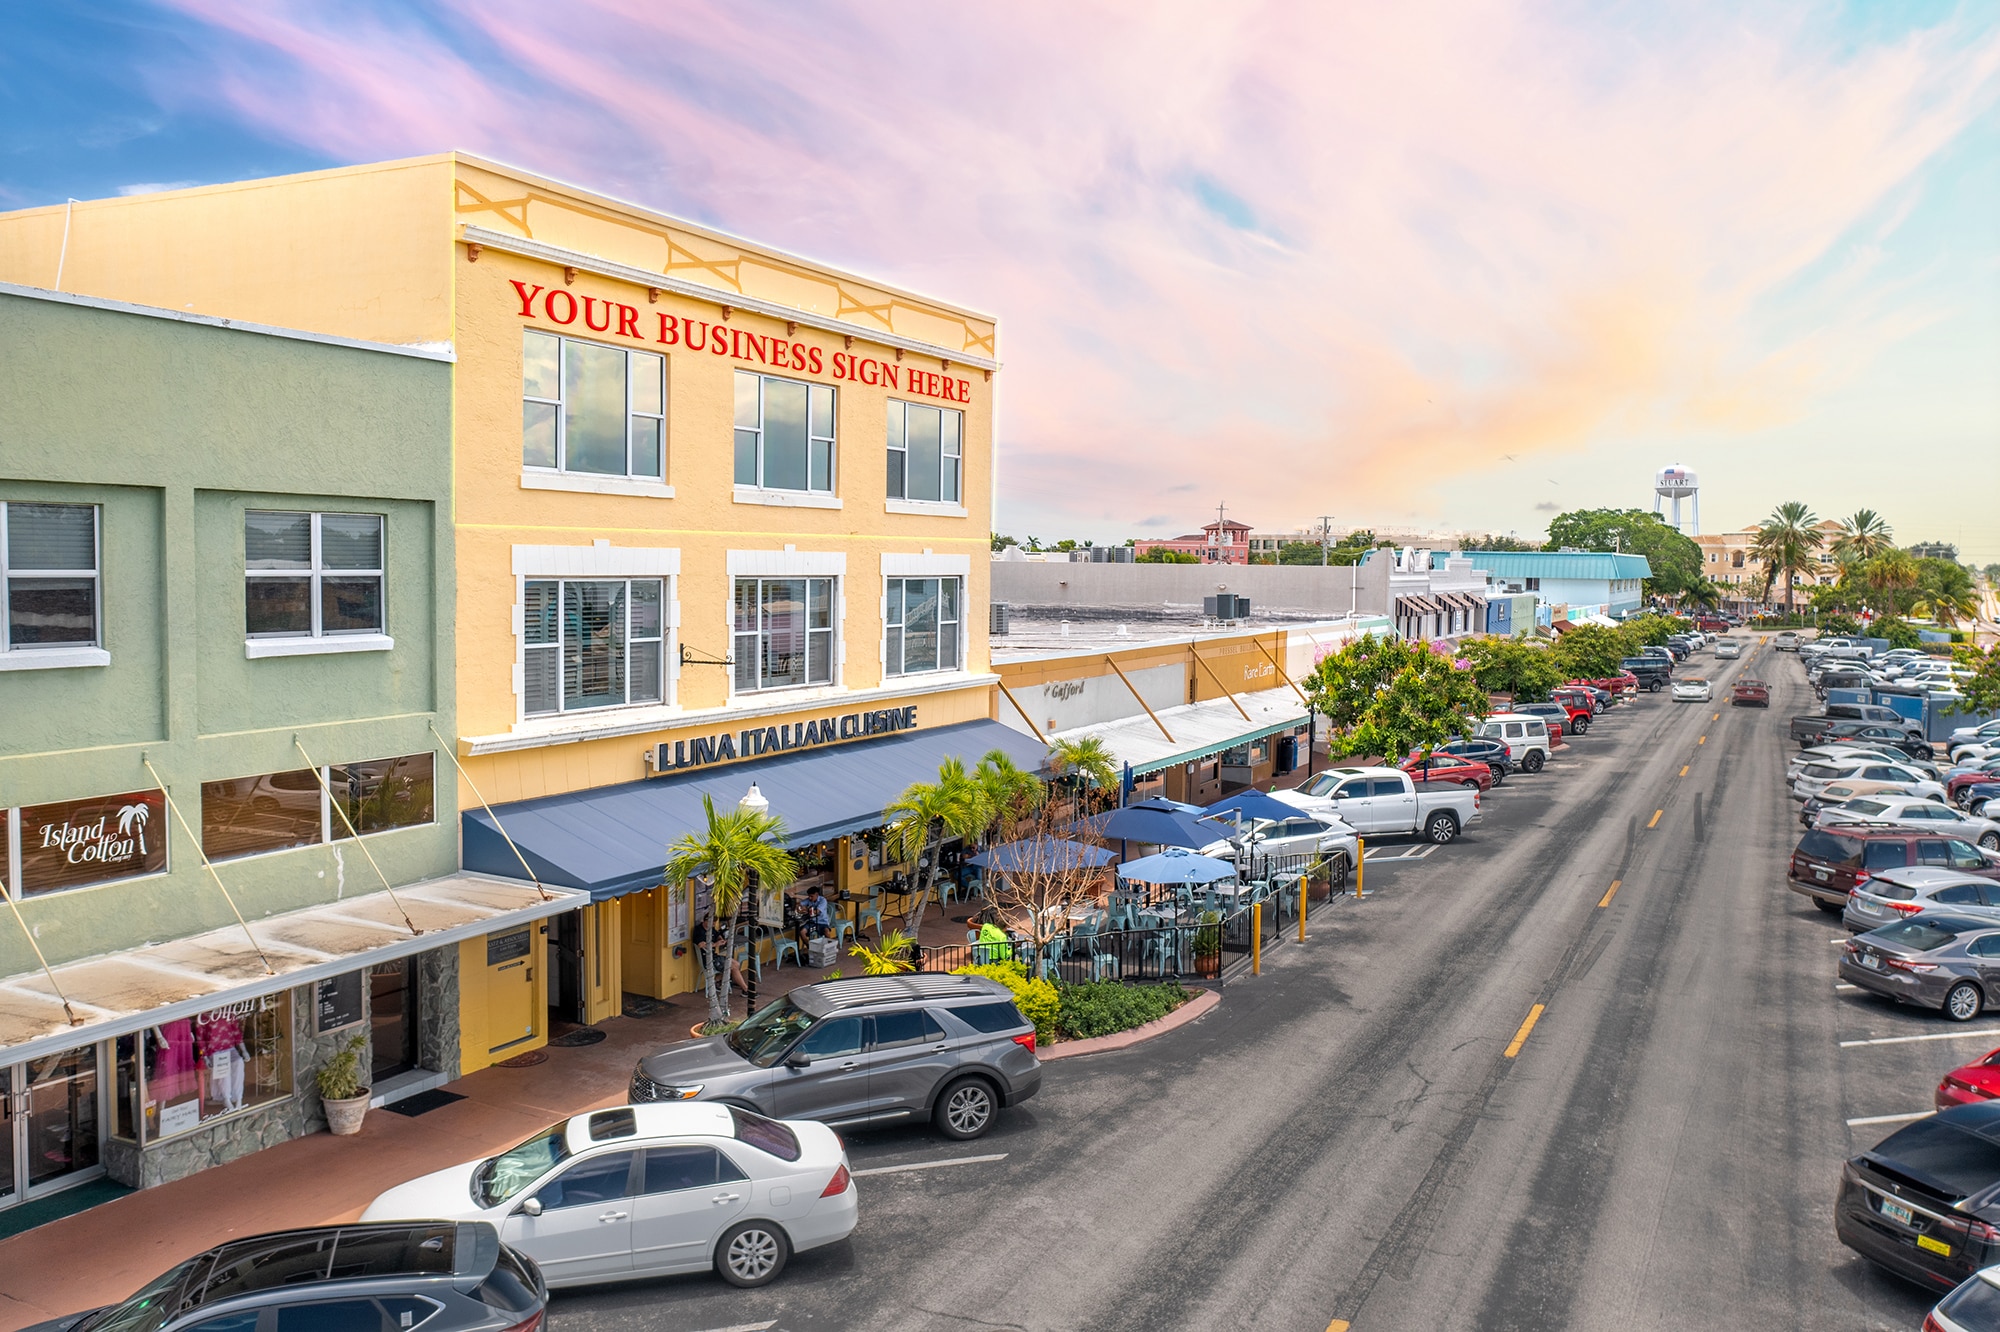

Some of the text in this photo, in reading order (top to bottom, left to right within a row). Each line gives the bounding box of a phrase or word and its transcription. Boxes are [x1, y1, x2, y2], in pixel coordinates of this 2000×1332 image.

[509, 279, 972, 404] YOUR BUSINESS SIGN HERE
[1660, 478, 1689, 487] STUART
[1244, 661, 1275, 680] Rare Earth
[1052, 681, 1085, 701] Gafford
[656, 705, 918, 772] LUNA ITALIAN CUISINE
[39, 816, 106, 851] Island
[67, 833, 134, 864] Cotton
